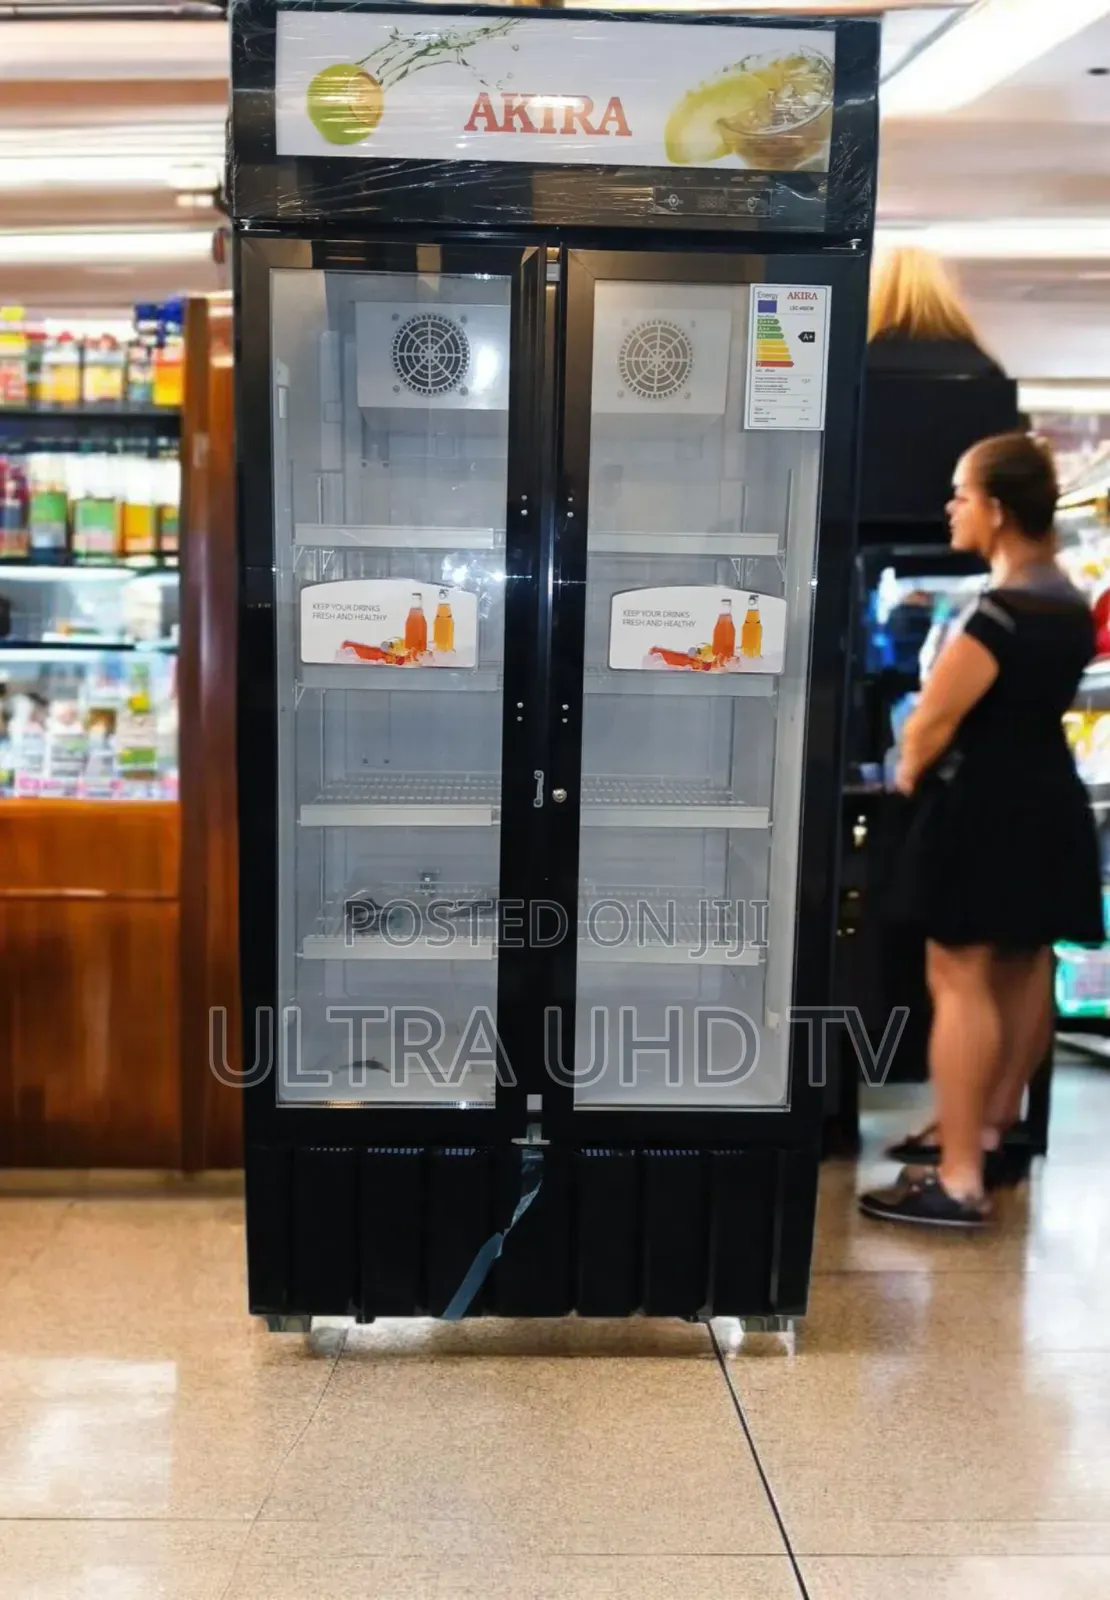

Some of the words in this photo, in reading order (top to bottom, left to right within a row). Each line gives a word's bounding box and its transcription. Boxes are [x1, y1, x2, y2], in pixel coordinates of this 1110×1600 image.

[463, 92, 632, 136] AKIRA
[787, 291, 818, 300] AKIRA
[331, 604, 352, 612] YOUR
[353, 604, 380, 613] DRINKS
[312, 612, 335, 620] FRESH
[336, 613, 353, 621] AND
[354, 613, 388, 622] HEALTHY
[622, 609, 641, 617] KEEP
[641, 610, 662, 618] YOUR
[662, 610, 690, 619] DRINKS
[622, 618, 645, 627] FRESH
[645, 619, 663, 627] AND
[664, 620, 696, 628] HEALTHY
